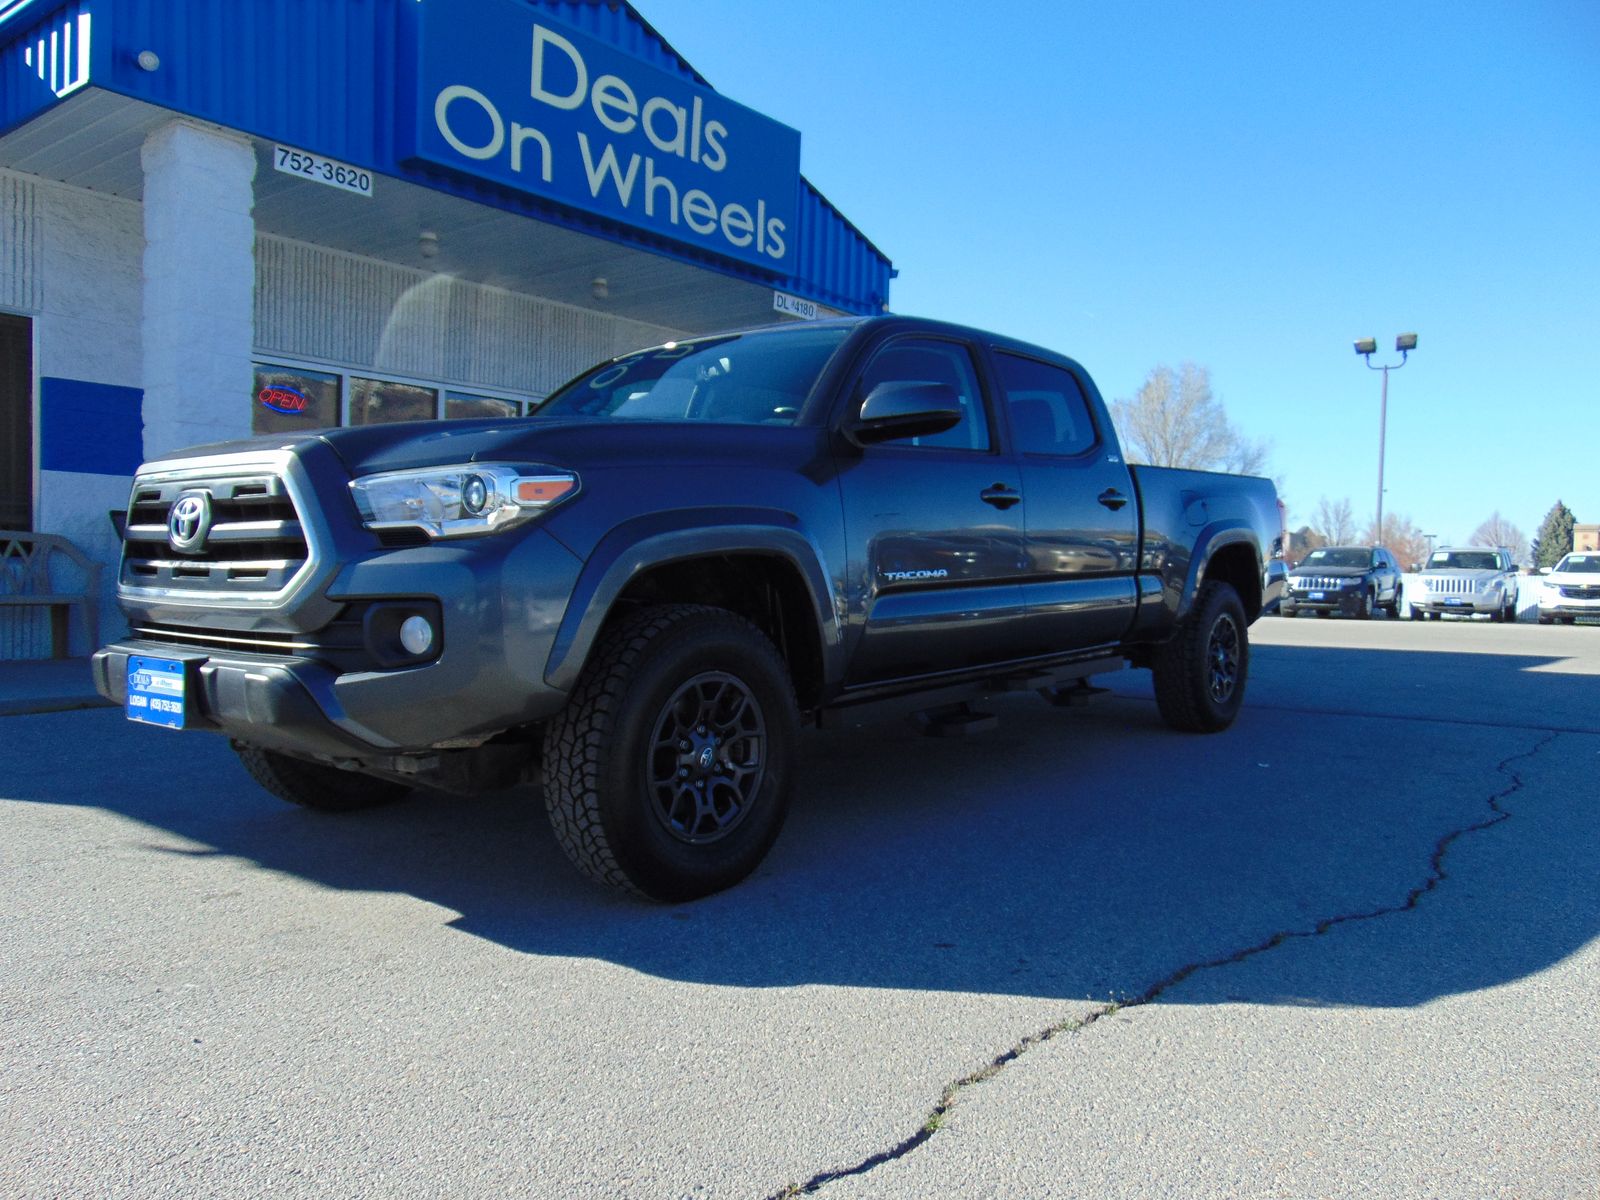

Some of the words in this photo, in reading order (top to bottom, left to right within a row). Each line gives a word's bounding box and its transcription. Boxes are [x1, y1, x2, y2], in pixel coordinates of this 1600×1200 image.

[530, 23, 727, 172] Deals
[277, 147, 370, 192] 752-3620
[434, 84, 552, 183] On
[577, 131, 786, 260] Wheels
[776, 294, 789, 310] DL
[259, 389, 305, 411] OPEN
[884, 569, 948, 581] TACOMA
